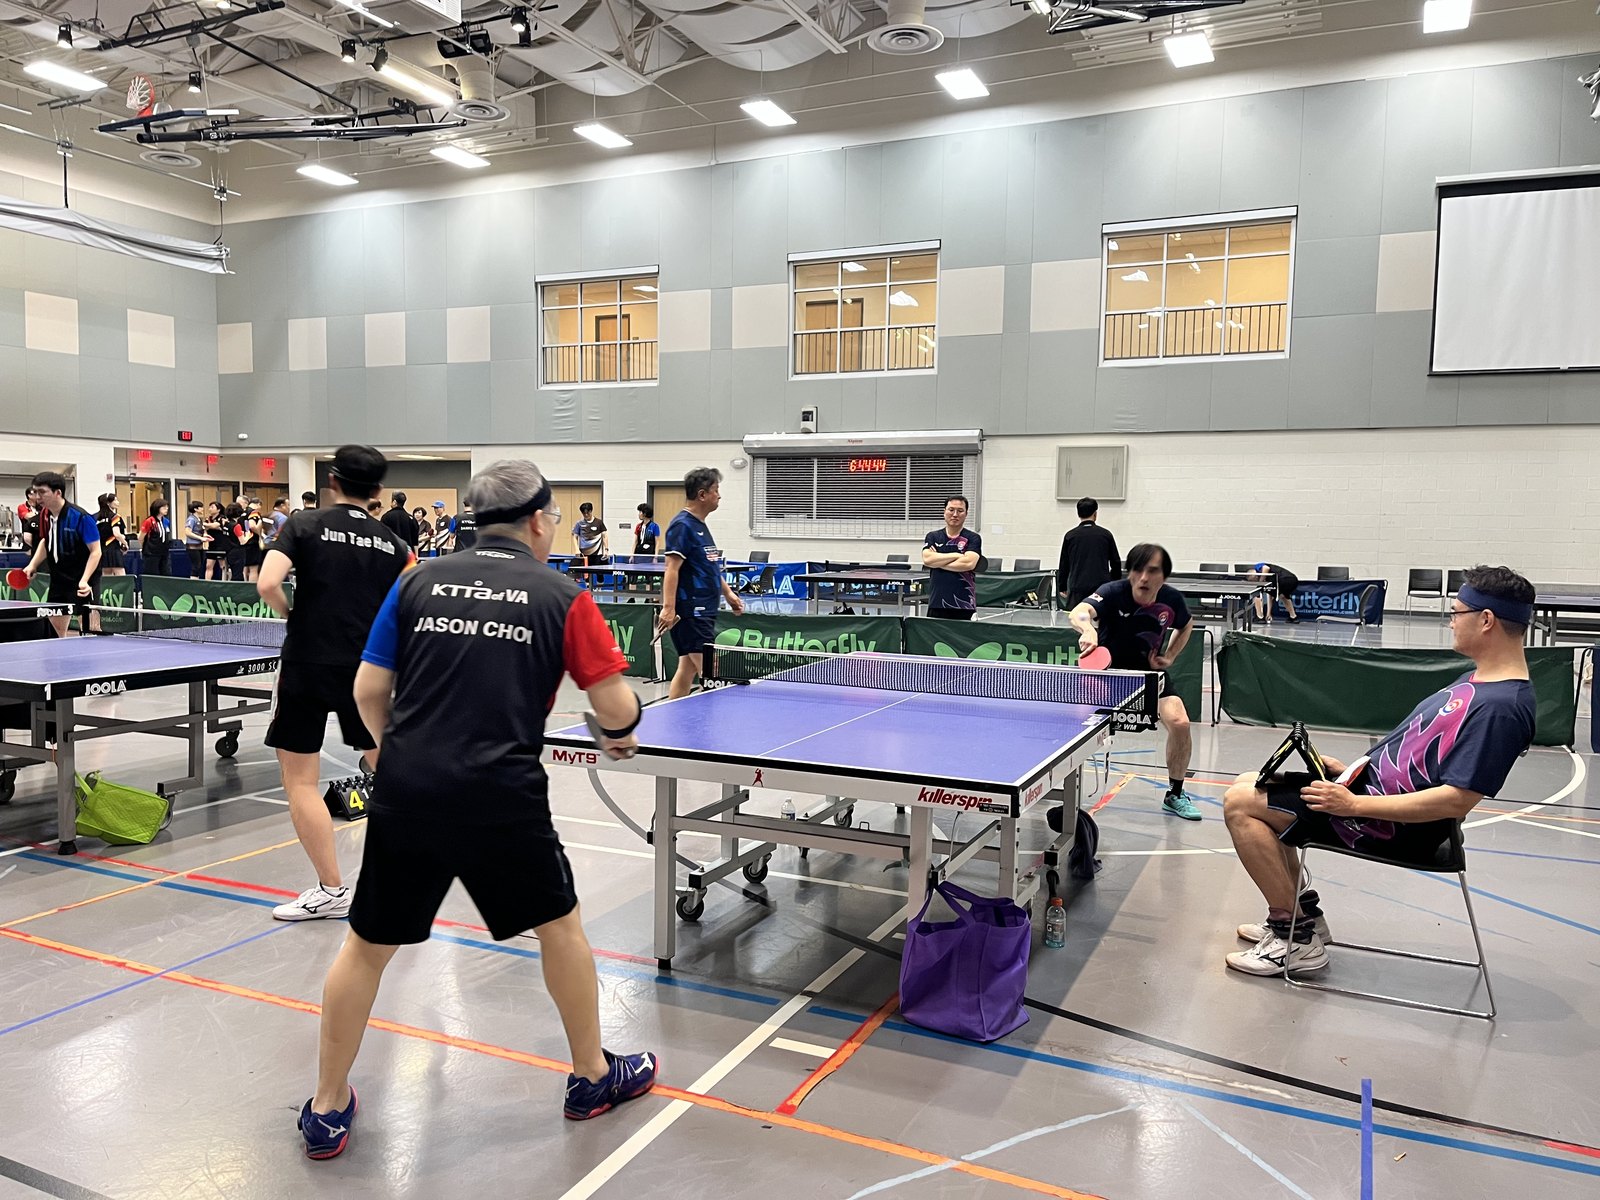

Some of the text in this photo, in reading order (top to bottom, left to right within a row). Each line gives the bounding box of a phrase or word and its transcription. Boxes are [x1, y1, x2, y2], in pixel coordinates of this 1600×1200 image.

[321, 527, 347, 543] Jun
[347, 531, 372, 548] Tae
[505, 588, 529, 605] VA
[1279, 591, 1361, 613] utterfly
[67, 604, 74, 615] 3
[414, 616, 533, 644] JASON CHOI
[742, 628, 878, 662] Butterfly
[247, 662, 266, 673] 3000
[44, 679, 127, 701] 1 JOOLA
[1112, 712, 1152, 725] JOOLA
[1123, 723, 1138, 731] WM
[349, 790, 365, 811] 4
